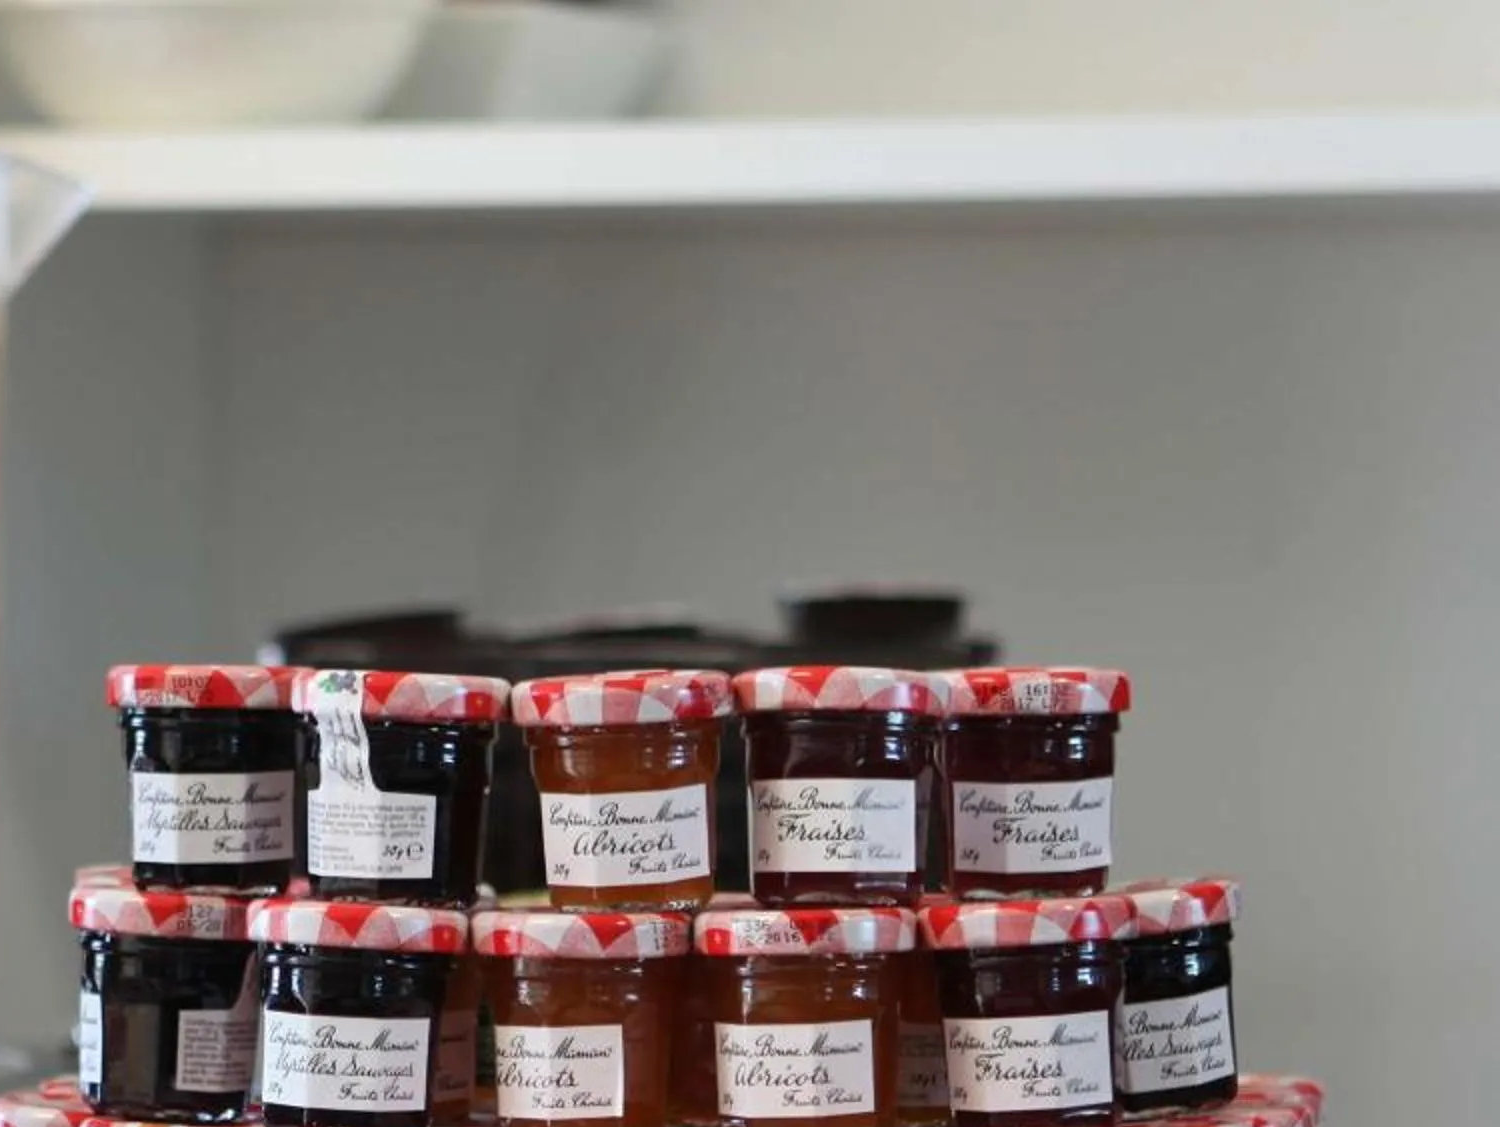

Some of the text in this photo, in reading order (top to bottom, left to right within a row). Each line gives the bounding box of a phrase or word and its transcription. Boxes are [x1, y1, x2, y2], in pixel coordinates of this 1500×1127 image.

[598, 800, 647, 827] Bonne
[778, 812, 867, 843] Fraises
[993, 816, 1080, 845] Fraises
[313, 1024, 362, 1051] Bonne
[754, 1033, 801, 1058] Bonne
[991, 1025, 1040, 1050] Bonne
[974, 1051, 1065, 1082] Fraises
